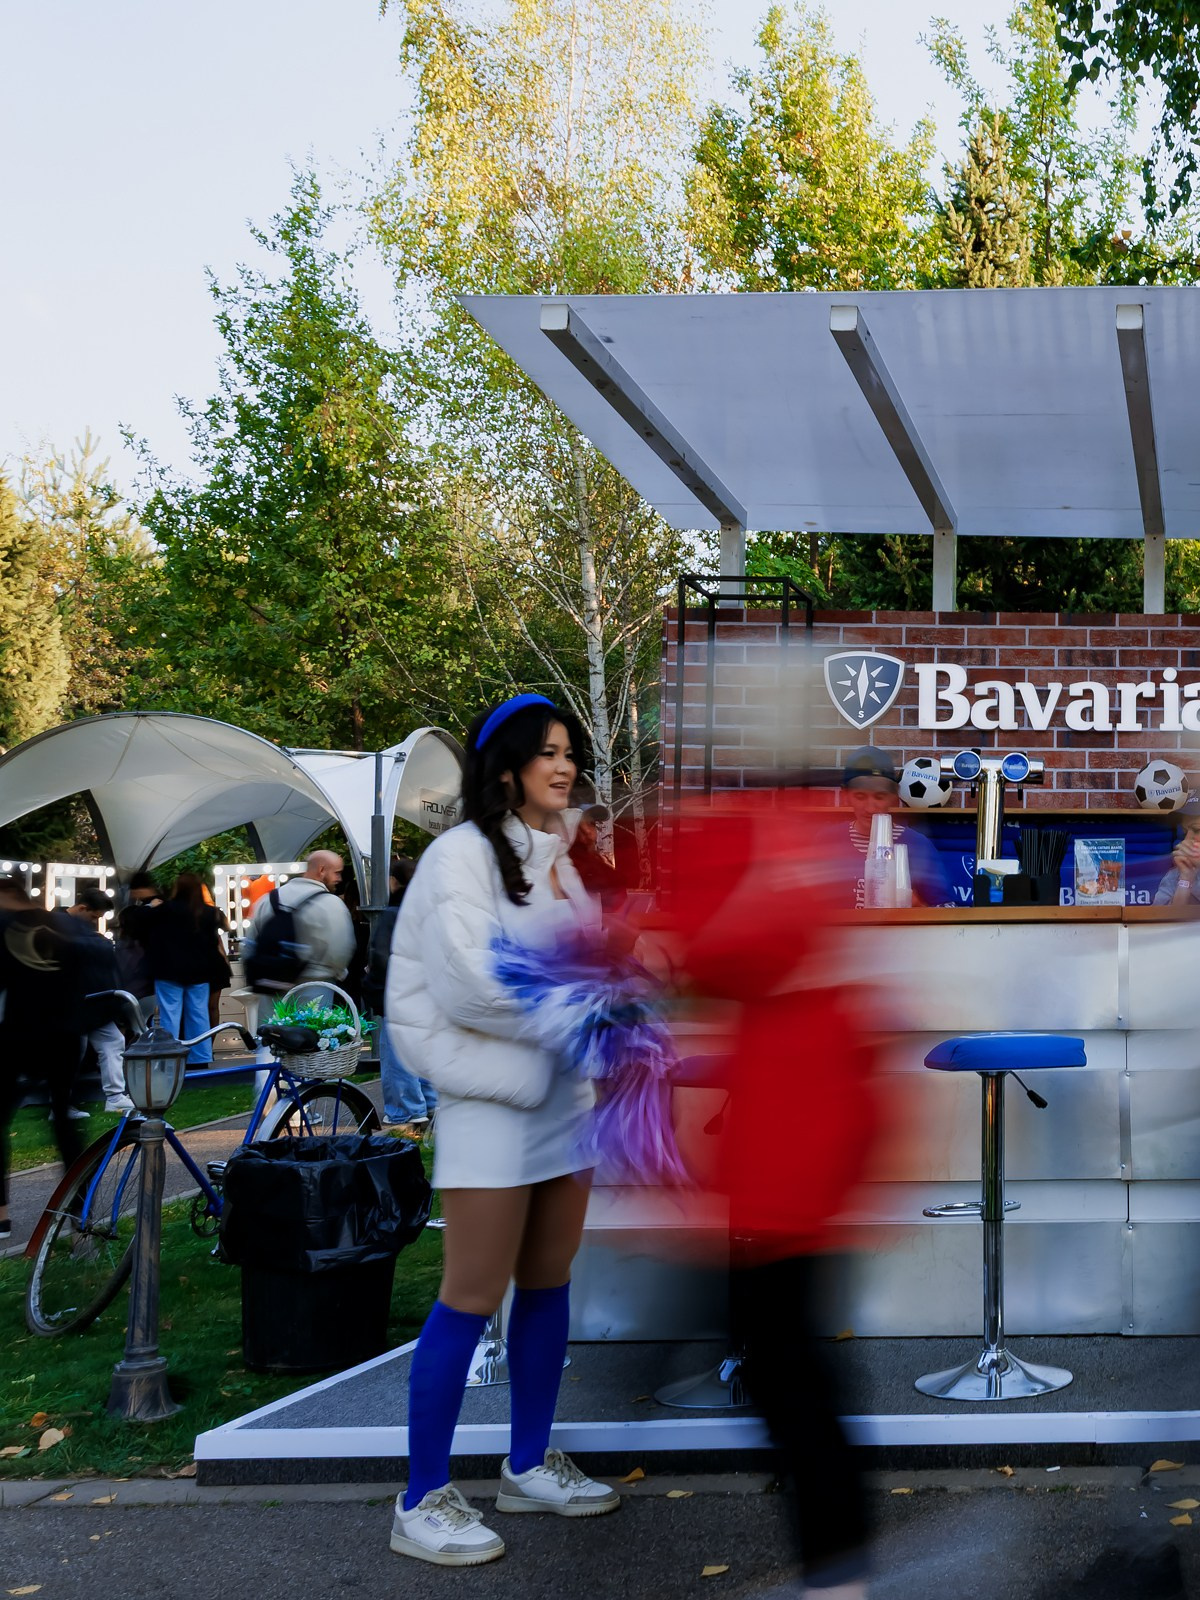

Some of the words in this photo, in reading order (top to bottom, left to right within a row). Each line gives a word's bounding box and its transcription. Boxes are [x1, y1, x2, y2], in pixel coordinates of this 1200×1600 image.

[857, 709, 865, 719] S
[911, 770, 938, 782] Bavaria
[1155, 786, 1181, 796] Bavaria
